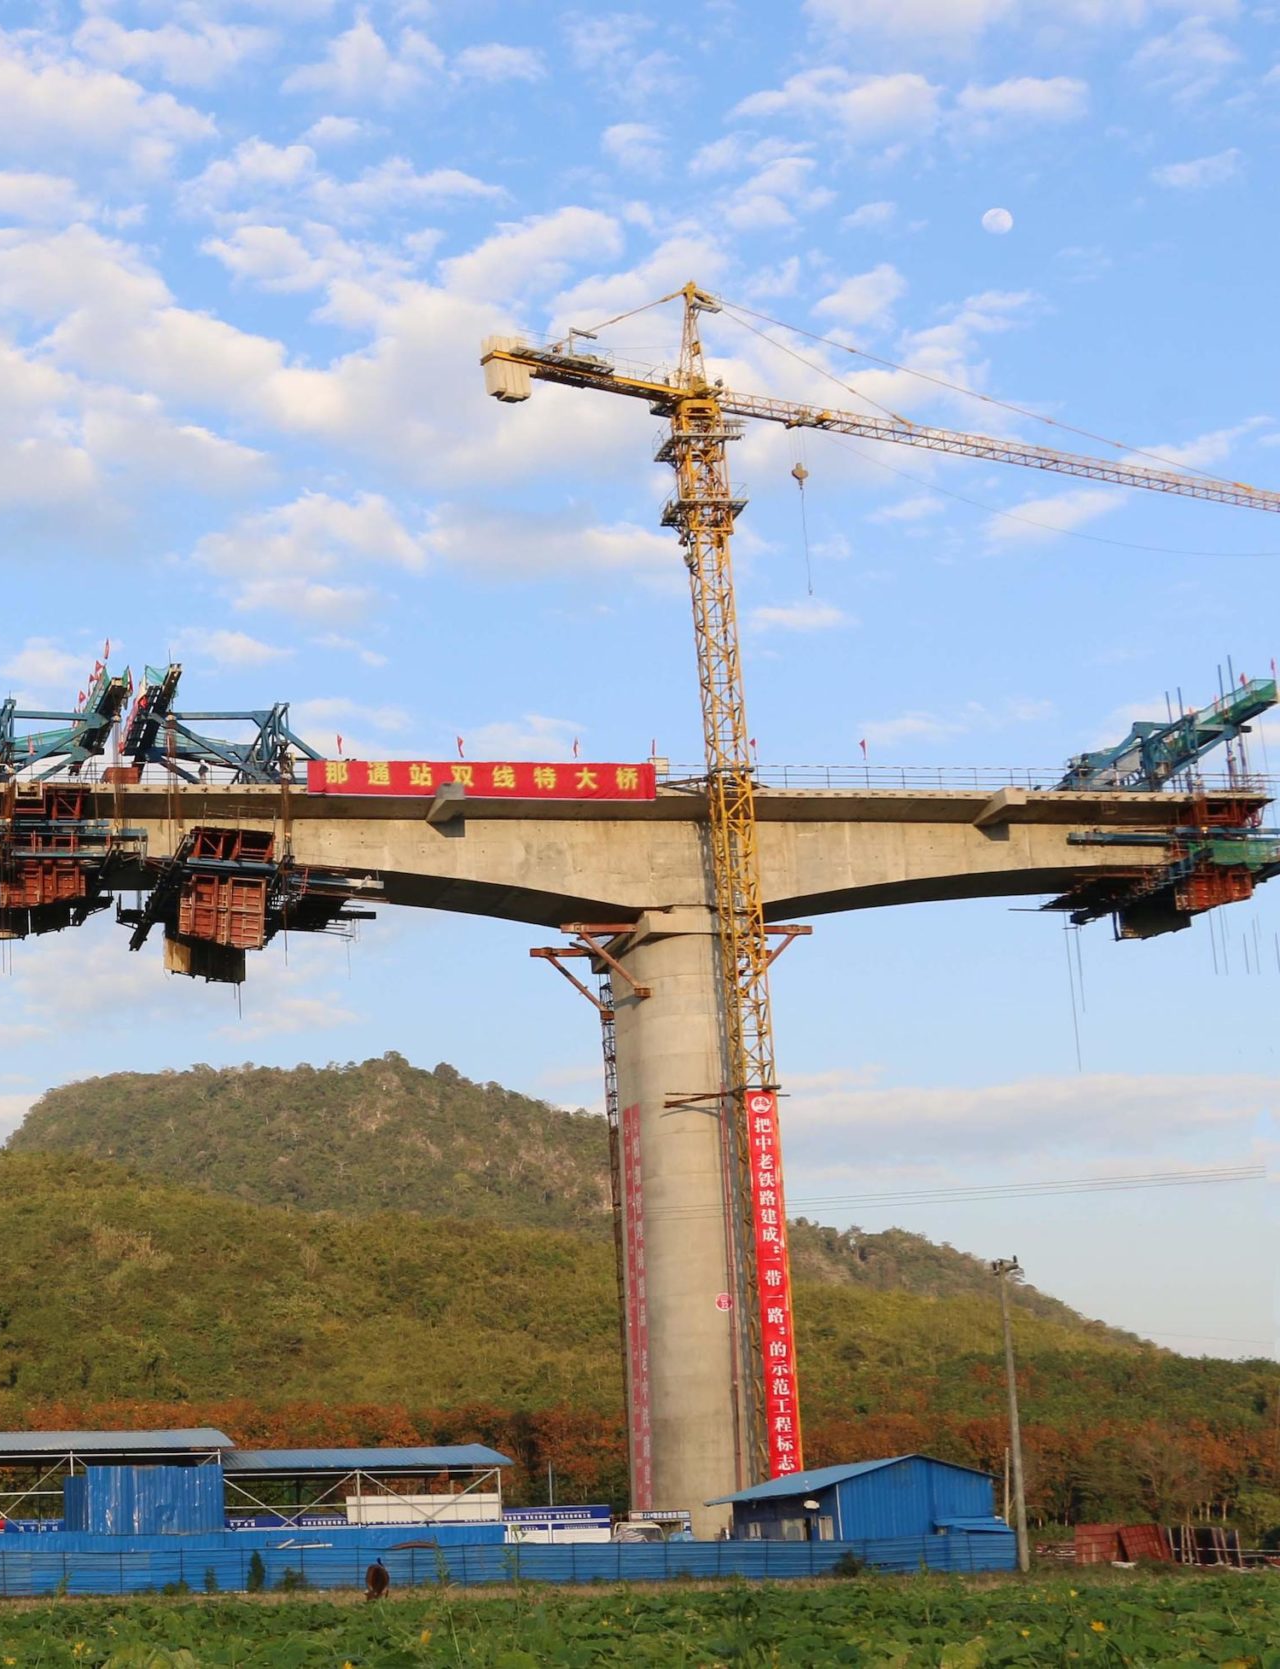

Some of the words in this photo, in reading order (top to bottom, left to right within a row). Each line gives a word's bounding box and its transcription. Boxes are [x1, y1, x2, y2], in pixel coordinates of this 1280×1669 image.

[325, 761, 639, 791] 那通站双线特大桥
[754, 1116, 796, 1478] 把中老铁路建成“一带一路”的示范工程标志
